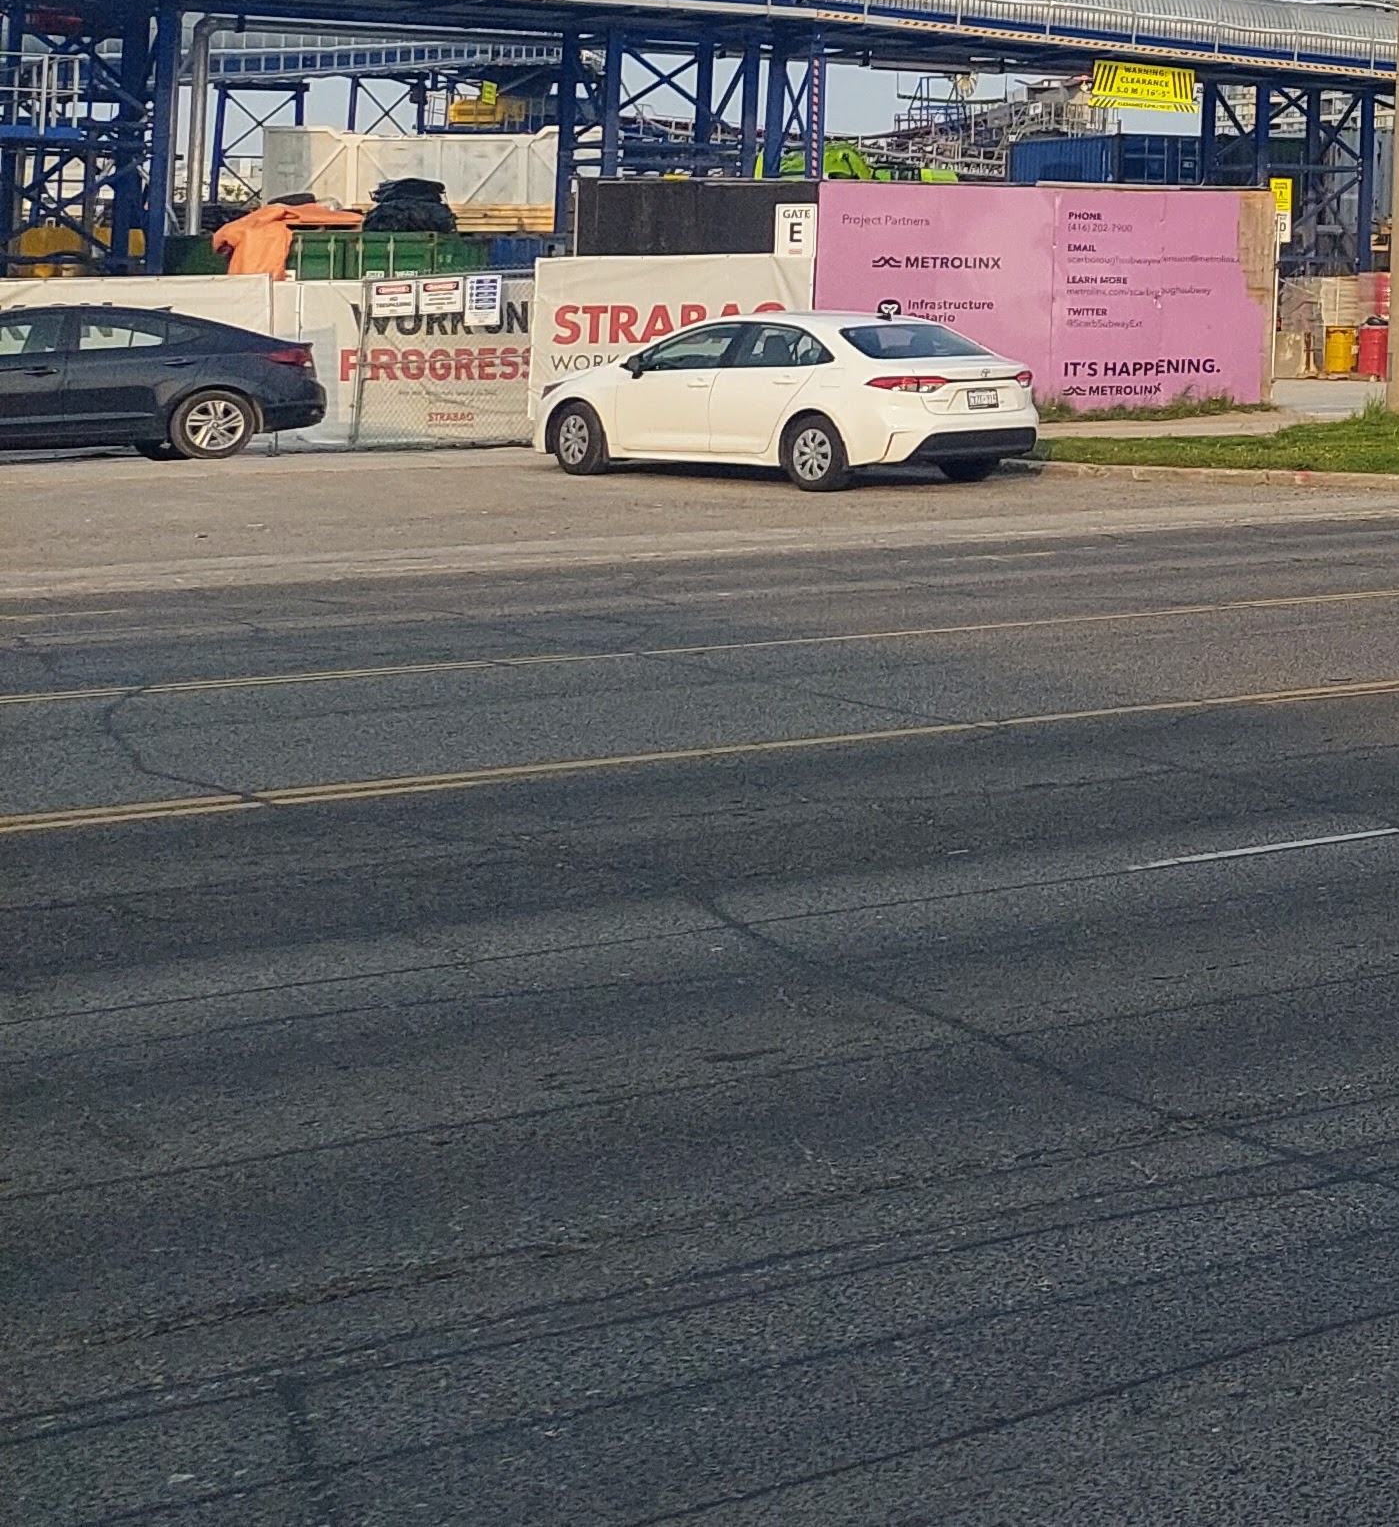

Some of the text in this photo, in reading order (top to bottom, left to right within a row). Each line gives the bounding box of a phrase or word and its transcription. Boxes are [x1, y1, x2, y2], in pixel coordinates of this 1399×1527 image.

[1120, 76, 1170, 88] CLEARANCE
[782, 209, 811, 219] GATE
[1068, 211, 1102, 221] PHONE
[842, 213, 930, 228] Project Partners
[789, 222, 802, 243] E
[1068, 223, 1090, 233] (416)
[1067, 243, 1097, 252] EMAIL
[904, 256, 1001, 270] METROLINX
[1066, 275, 1128, 285] LEARN MORE
[907, 299, 994, 310] Infrastructure
[1066, 308, 1108, 316] TWITTER
[350, 301, 474, 336] WORK
[552, 302, 786, 345] STRA
[1063, 358, 1221, 377] IT'S HAPPENING.
[1088, 382, 1162, 396] METROLINX
[427, 412, 474, 422] STRABAG
